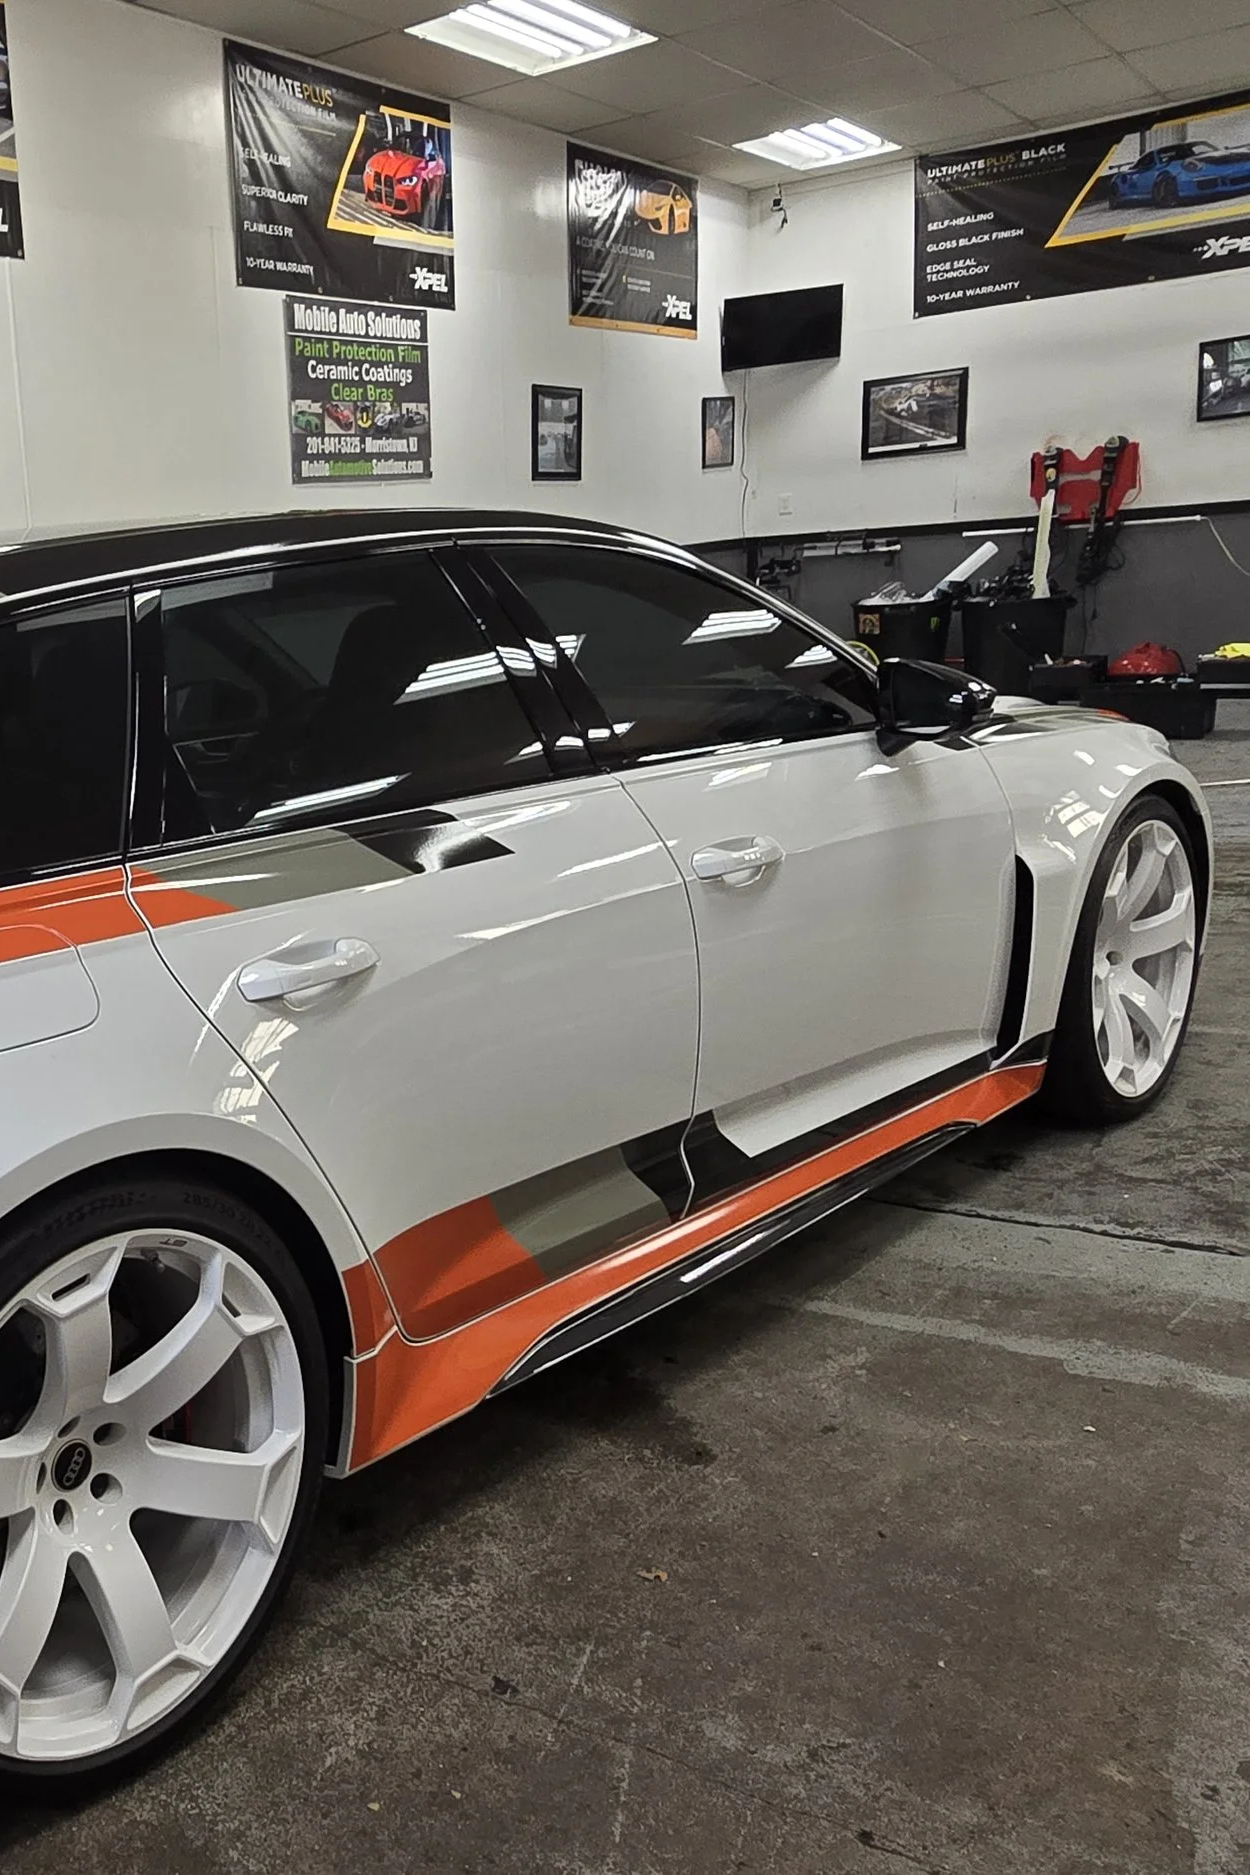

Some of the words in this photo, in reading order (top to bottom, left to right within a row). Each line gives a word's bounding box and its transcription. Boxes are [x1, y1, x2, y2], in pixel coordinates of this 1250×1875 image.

[1021, 142, 1067, 160] BLACK
[241, 183, 278, 200] SUPERIOR
[278, 191, 309, 206] CLARITY
[243, 220, 284, 237] FLAWLESS
[284, 226, 294, 238] FIT
[927, 211, 995, 232] SELF-HEALING
[926, 239, 958, 252] GLOSS
[958, 233, 990, 247] BLACK
[991, 228, 1024, 241] FINISH
[245, 256, 275, 271] 10-YEAR
[275, 261, 314, 276] WARRANTY
[926, 261, 952, 273] EDGE
[953, 258, 977, 269] SEAL
[926, 264, 991, 282] TECHNOLOGY
[414, 266, 449, 293] XPEL
[926, 290, 964, 303] 10-YEAR
[965, 280, 1021, 297] WARRANTY
[665, 294, 693, 320] XPEL
[293, 302, 338, 333] Mobile
[338, 308, 367, 336] Auto
[367, 311, 421, 340] Solutions
[294, 337, 329, 358] Paint
[332, 341, 395, 362] Protection
[397, 345, 422, 363] Film
[307, 359, 359, 381] Ceramic
[361, 363, 413, 387] Coatings
[331, 383, 364, 401] Clear
[366, 384, 394, 401] Bras
